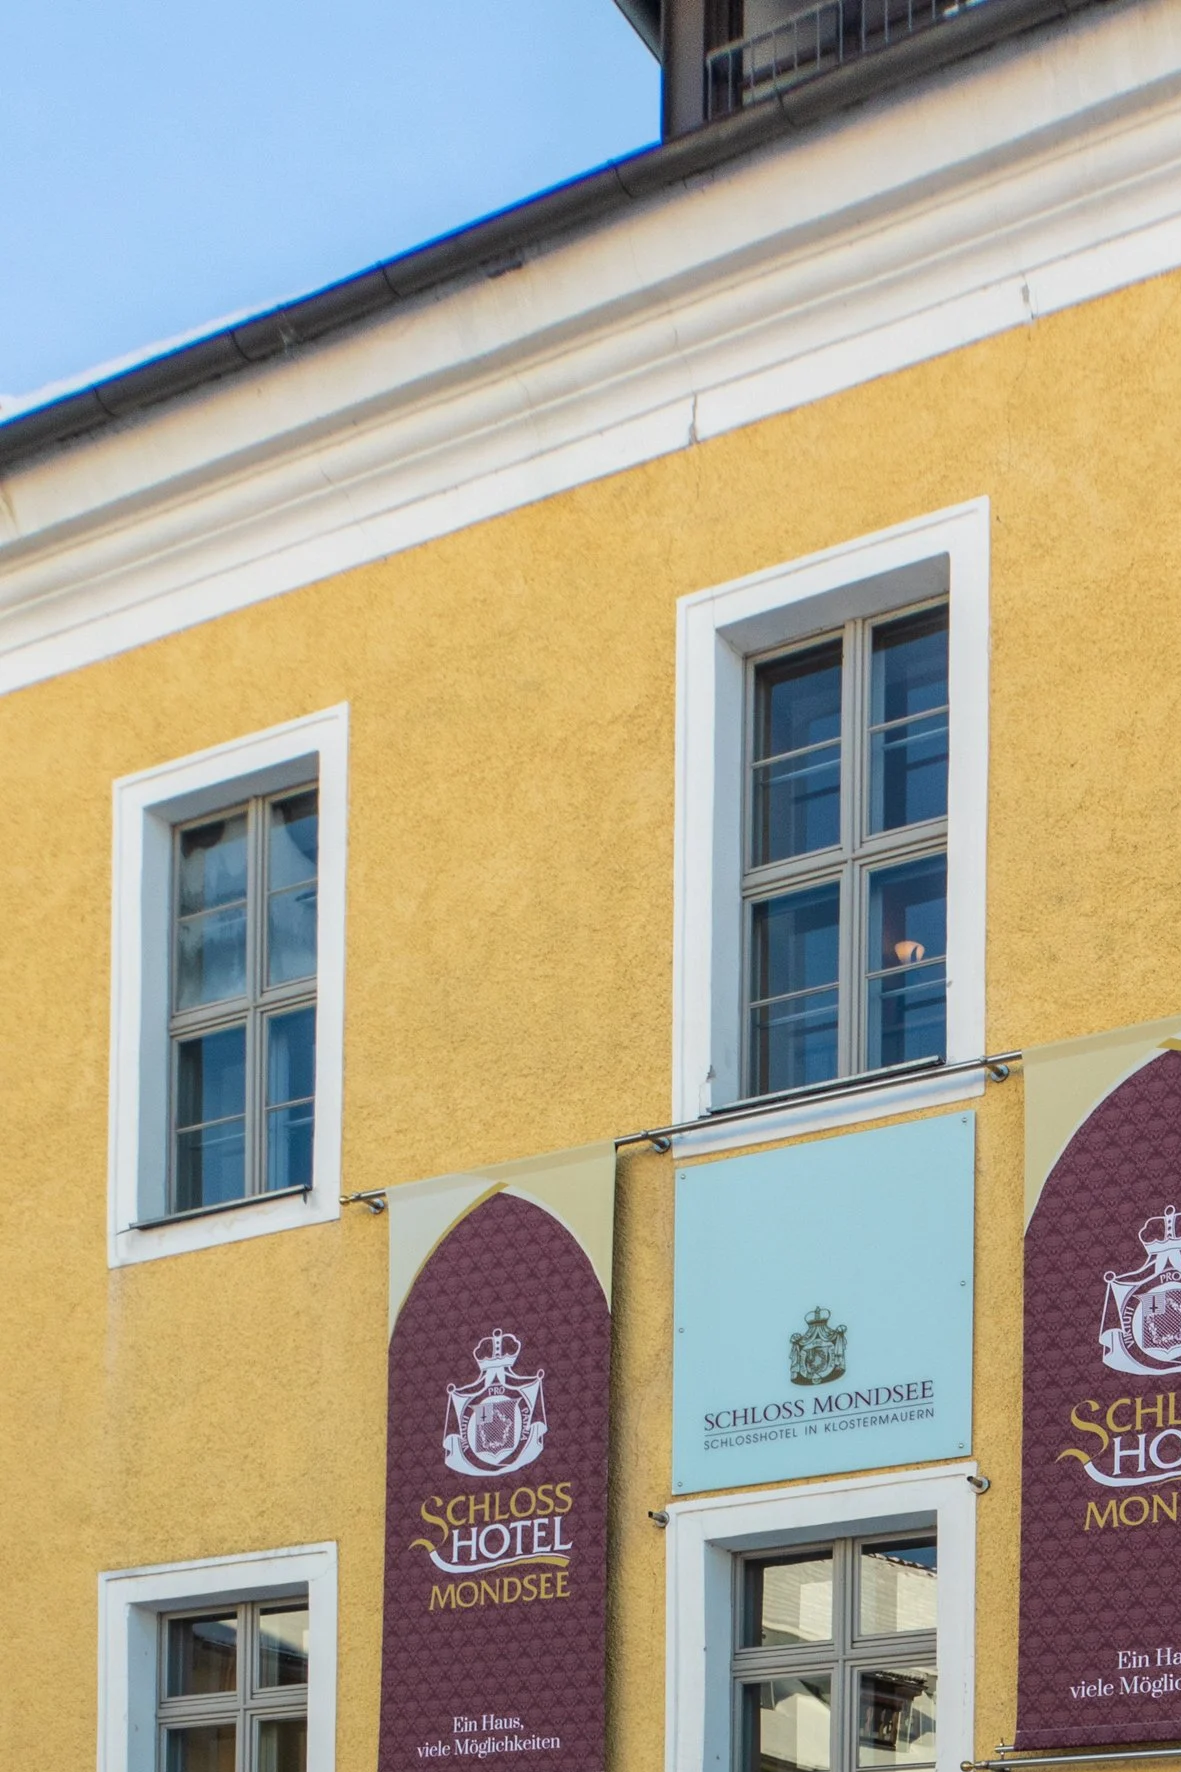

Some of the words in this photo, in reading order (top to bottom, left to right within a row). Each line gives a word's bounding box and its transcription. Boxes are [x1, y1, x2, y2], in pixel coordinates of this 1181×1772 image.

[1159, 1271, 1181, 1284] PRO
[487, 1386, 506, 1396] PRO
[703, 1398, 805, 1431] SCHLOSS
[813, 1379, 934, 1414] MONDSEE
[703, 1426, 798, 1451] SCHLOSSHOTEL
[804, 1425, 817, 1436] IN
[824, 1407, 935, 1433] KLOSTERMAUERN
[420, 1482, 574, 1543] SCHLOSS
[451, 1517, 573, 1564] HOTEL
[429, 1571, 571, 1611] MONDSEE
[1117, 1649, 1150, 1670] Ein
[1069, 1678, 1114, 1699] viele
[453, 1716, 478, 1733] Ein
[481, 1713, 525, 1731] Haus,
[416, 1741, 451, 1758] viele
[454, 1734, 561, 1759] Möglichkeiten
